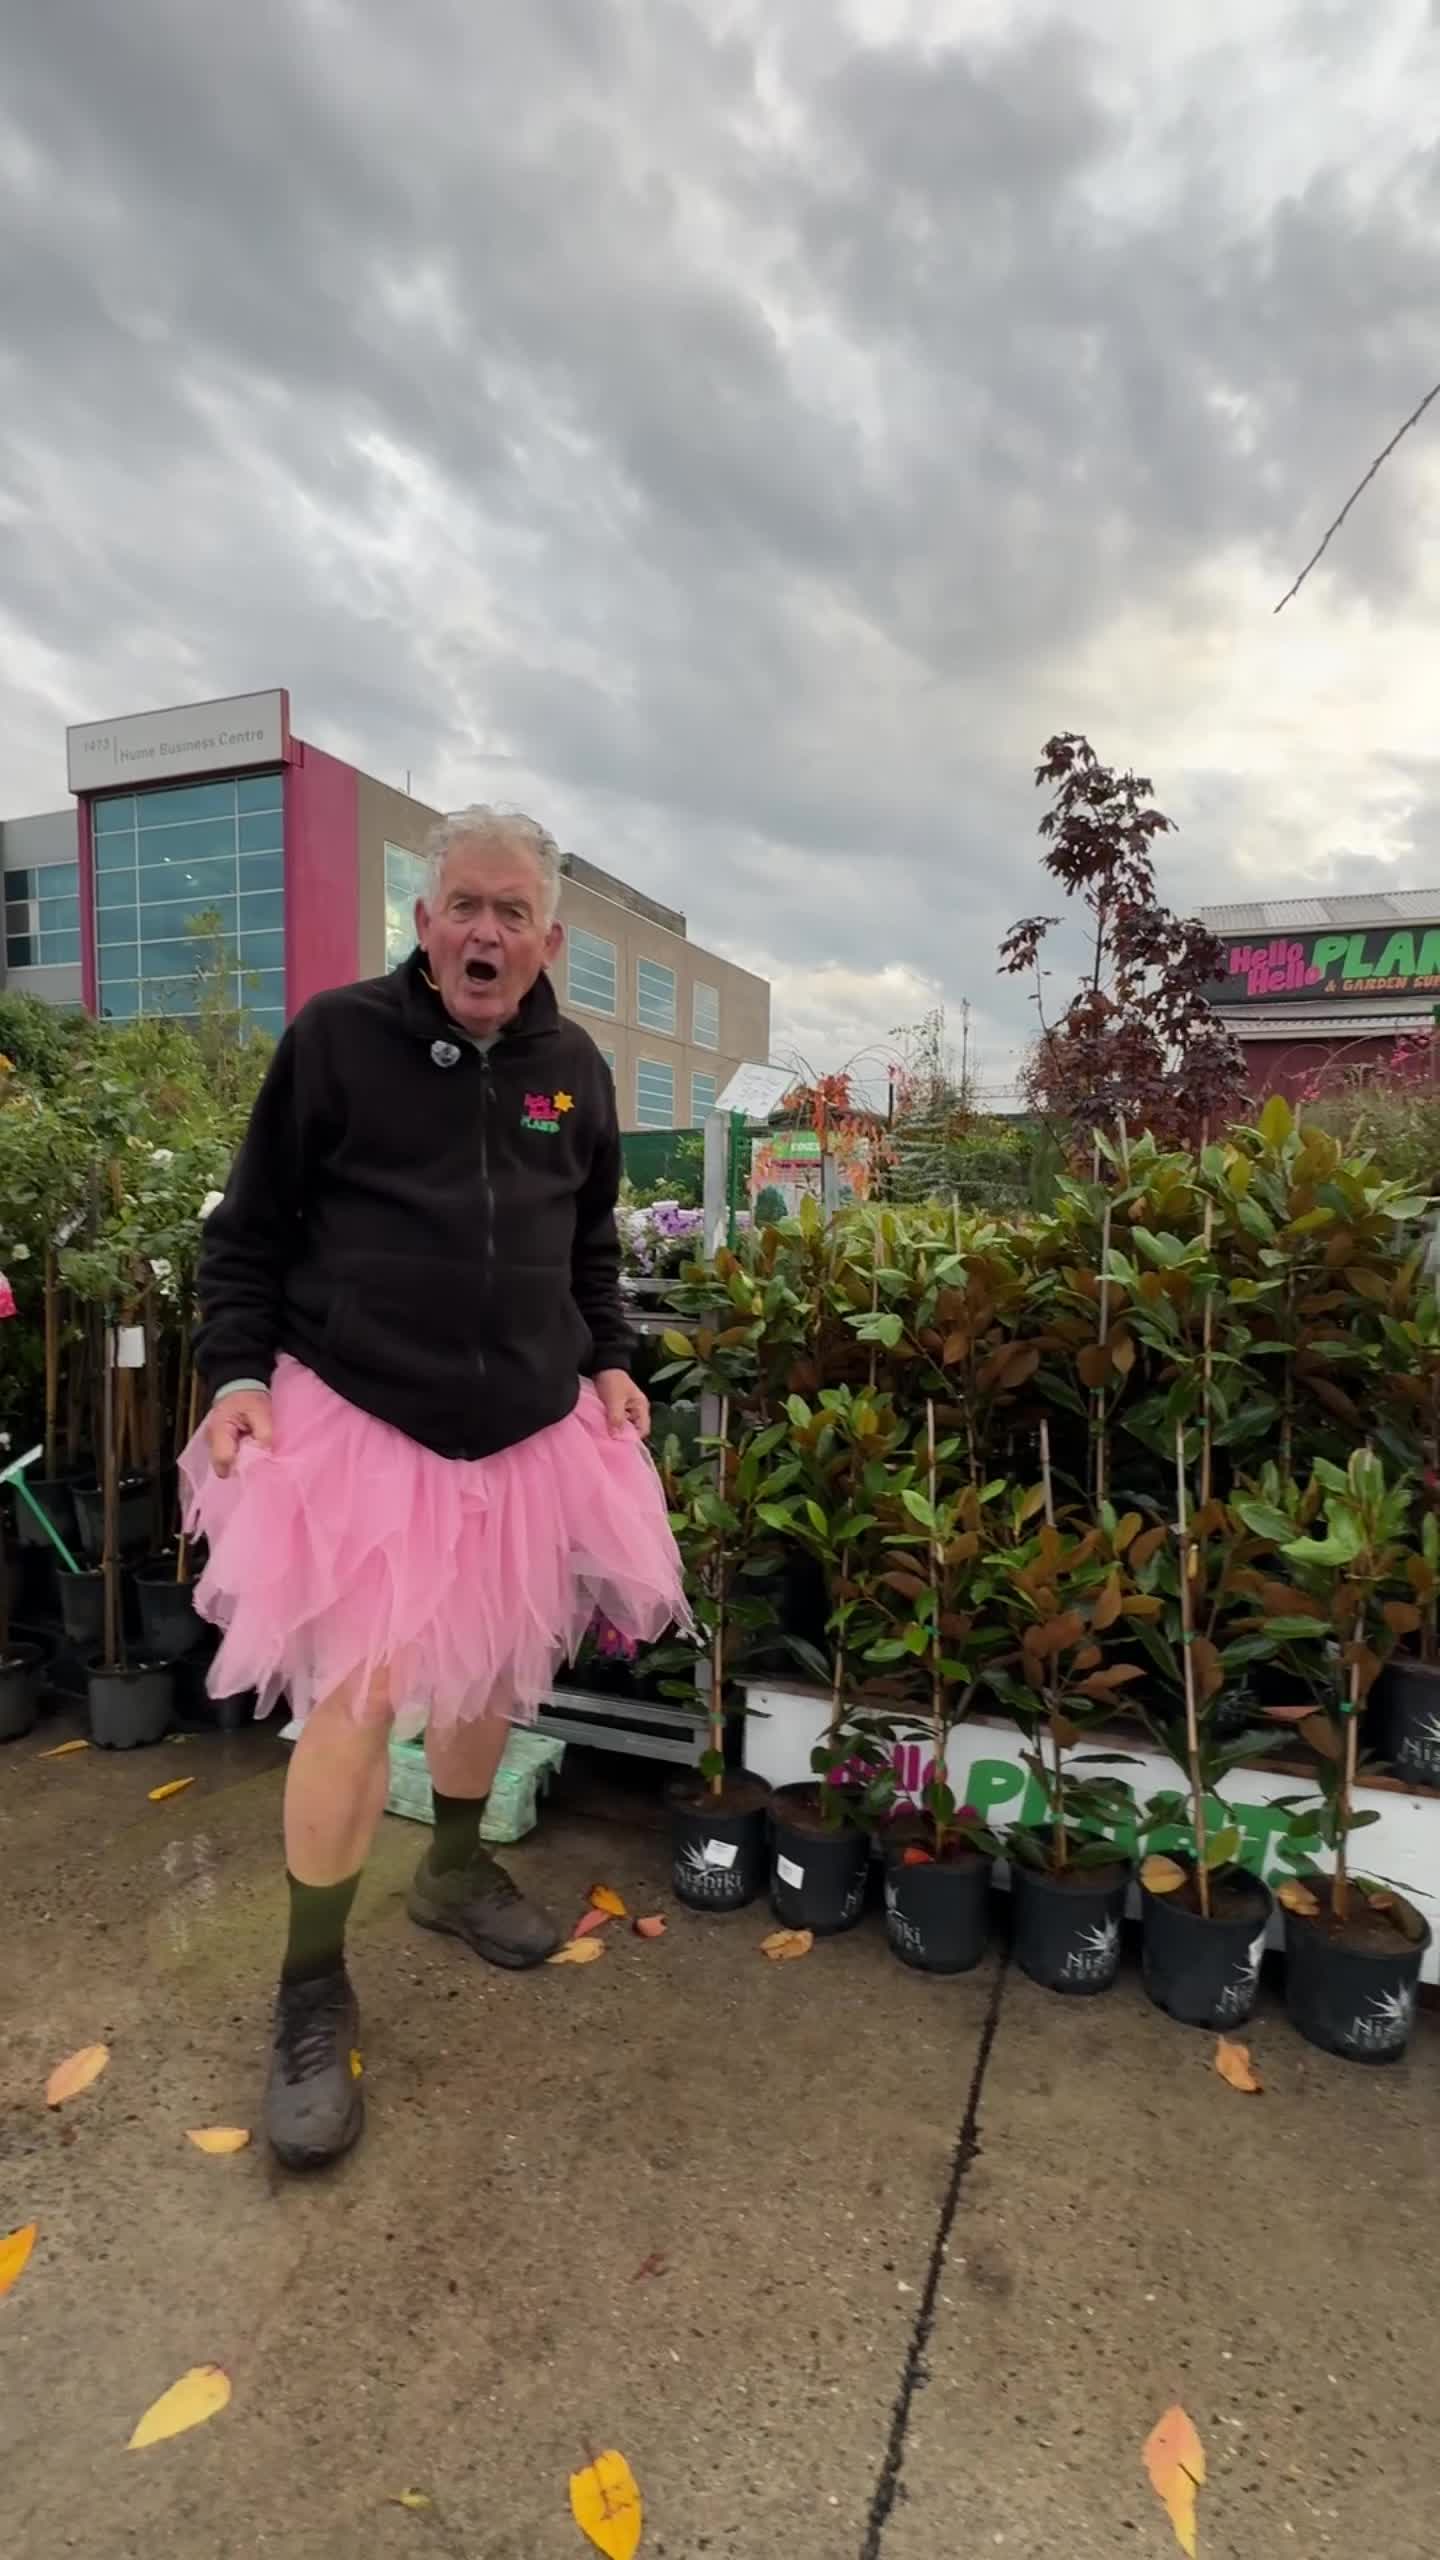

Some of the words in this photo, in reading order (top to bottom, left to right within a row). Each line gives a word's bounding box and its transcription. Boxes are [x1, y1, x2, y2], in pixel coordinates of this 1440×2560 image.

[160, 738, 216, 755] Business
[219, 730, 264, 746] Centre
[1229, 938, 1304, 974] Hello
[1247, 959, 1321, 996] Hello
[1324, 978, 1337, 993] &
[1342, 975, 1409, 991] GARDEN
